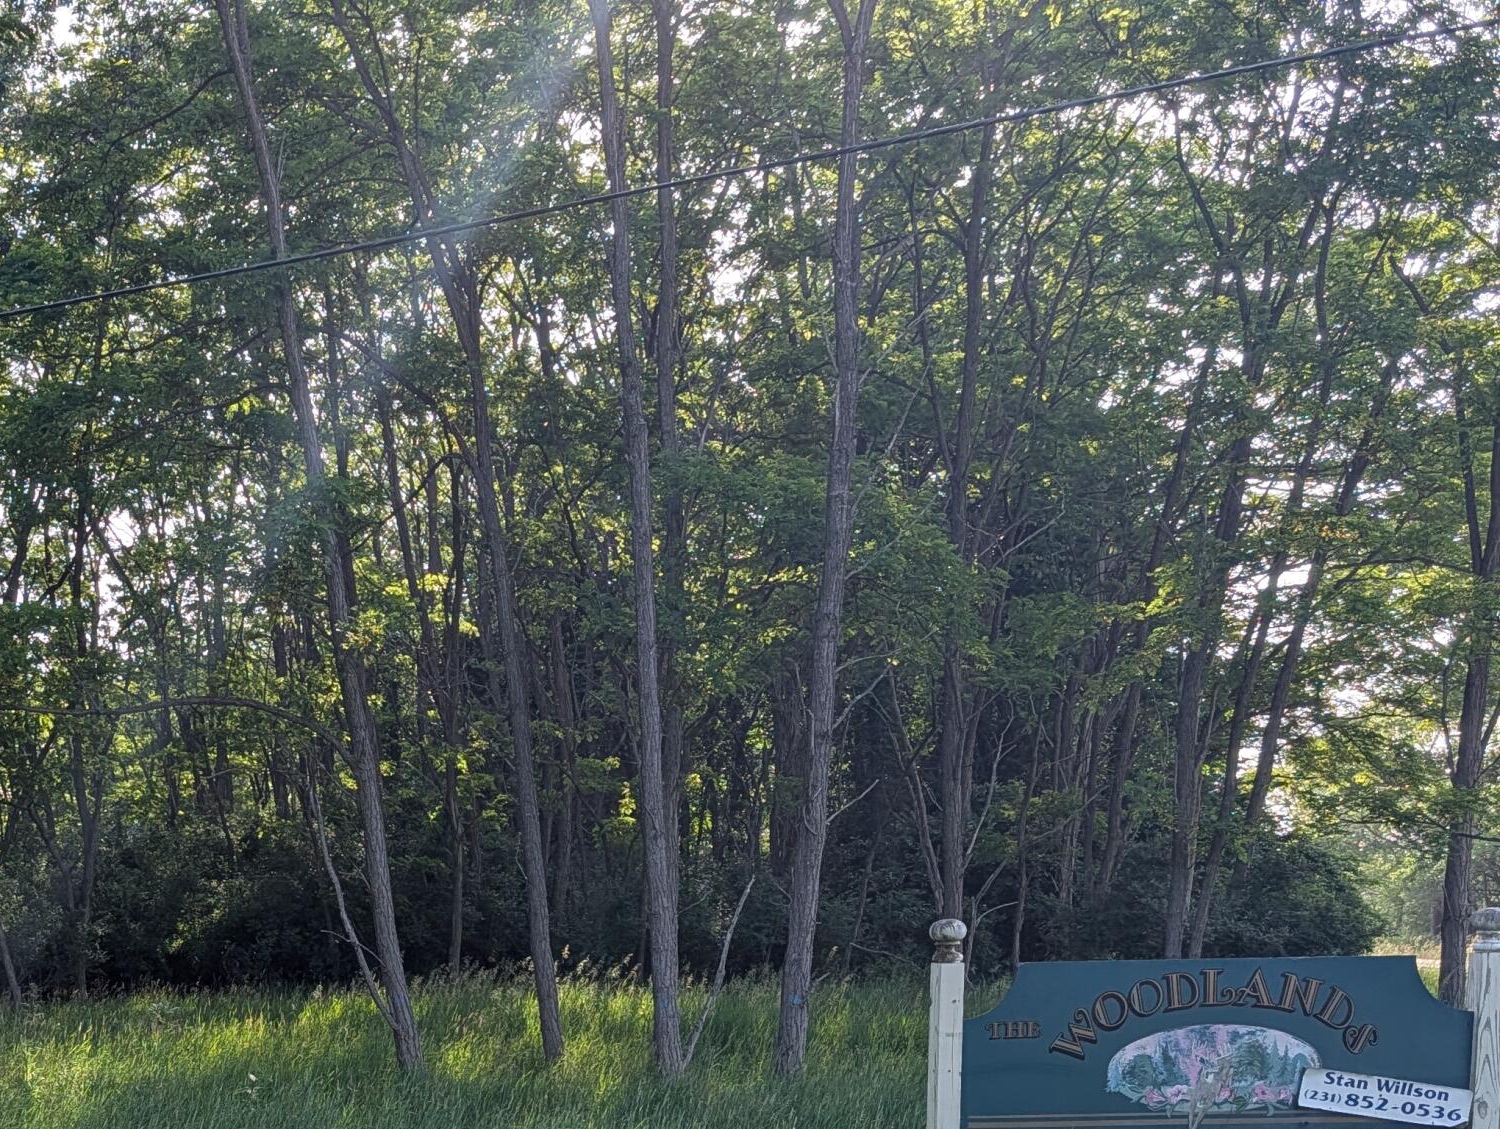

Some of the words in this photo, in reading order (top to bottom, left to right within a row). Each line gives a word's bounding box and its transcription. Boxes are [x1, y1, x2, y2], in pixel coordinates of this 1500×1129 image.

[985, 1020, 1043, 1040] THE
[1049, 967, 1379, 1059] WOODLANDS
[1324, 1071, 1368, 1090] Stan
[1376, 1078, 1450, 1101] Willson
[1304, 1089, 1342, 1104] (231)
[1344, 1093, 1462, 1121] 852-0536
